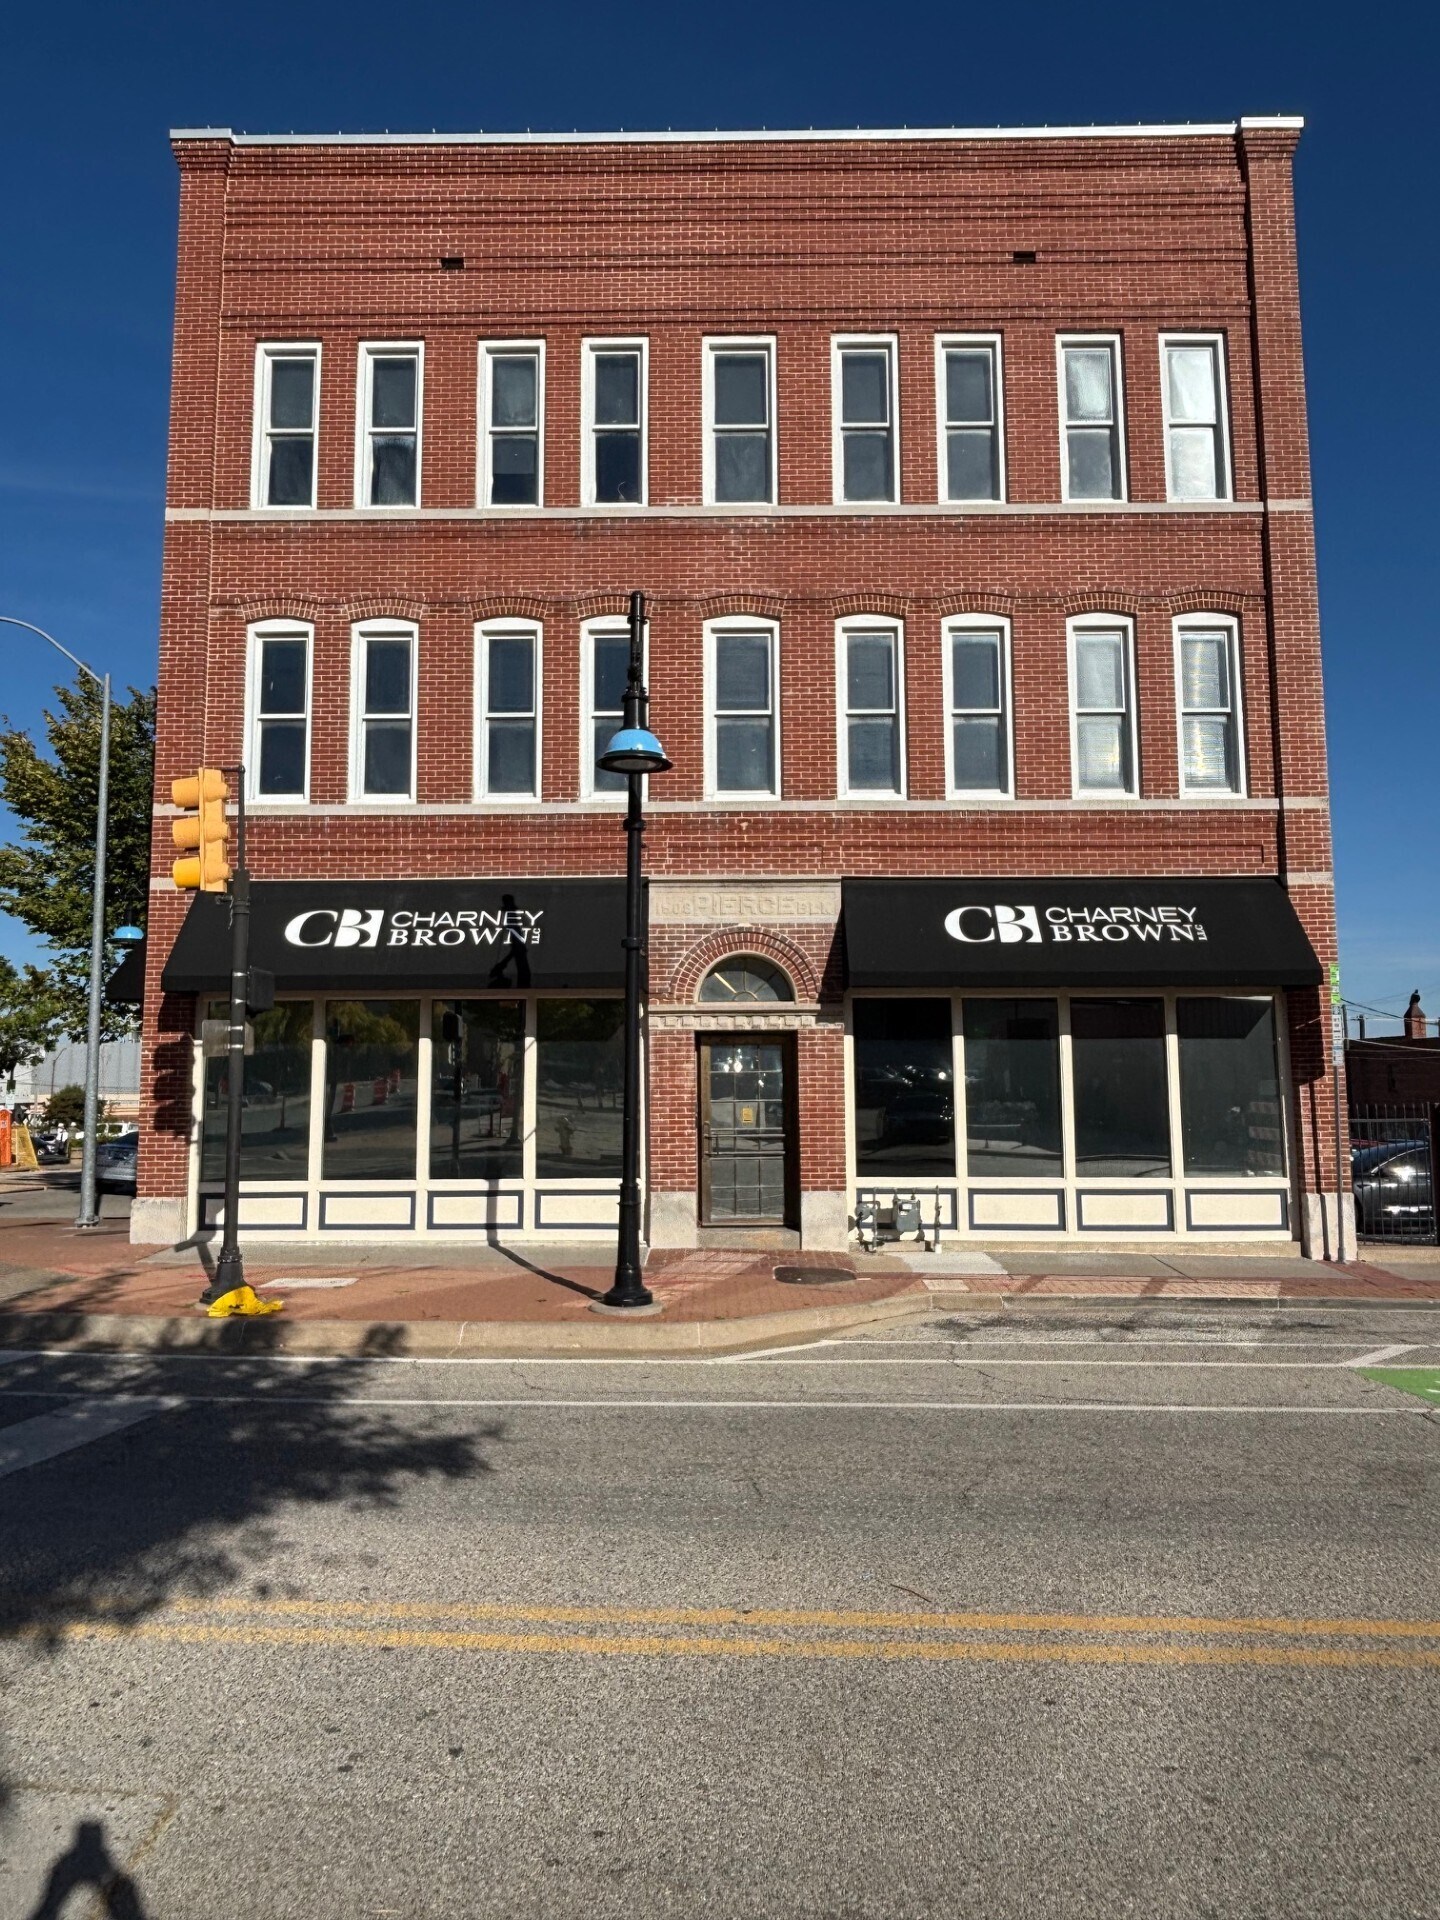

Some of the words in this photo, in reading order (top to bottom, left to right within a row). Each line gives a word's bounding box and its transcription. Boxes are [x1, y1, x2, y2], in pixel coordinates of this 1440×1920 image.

[391, 910, 544, 928] CHARNEY
[1045, 906, 1197, 923] CHARNEY
[387, 928, 531, 946] BROWN
[1050, 924, 1194, 942] BROWN
